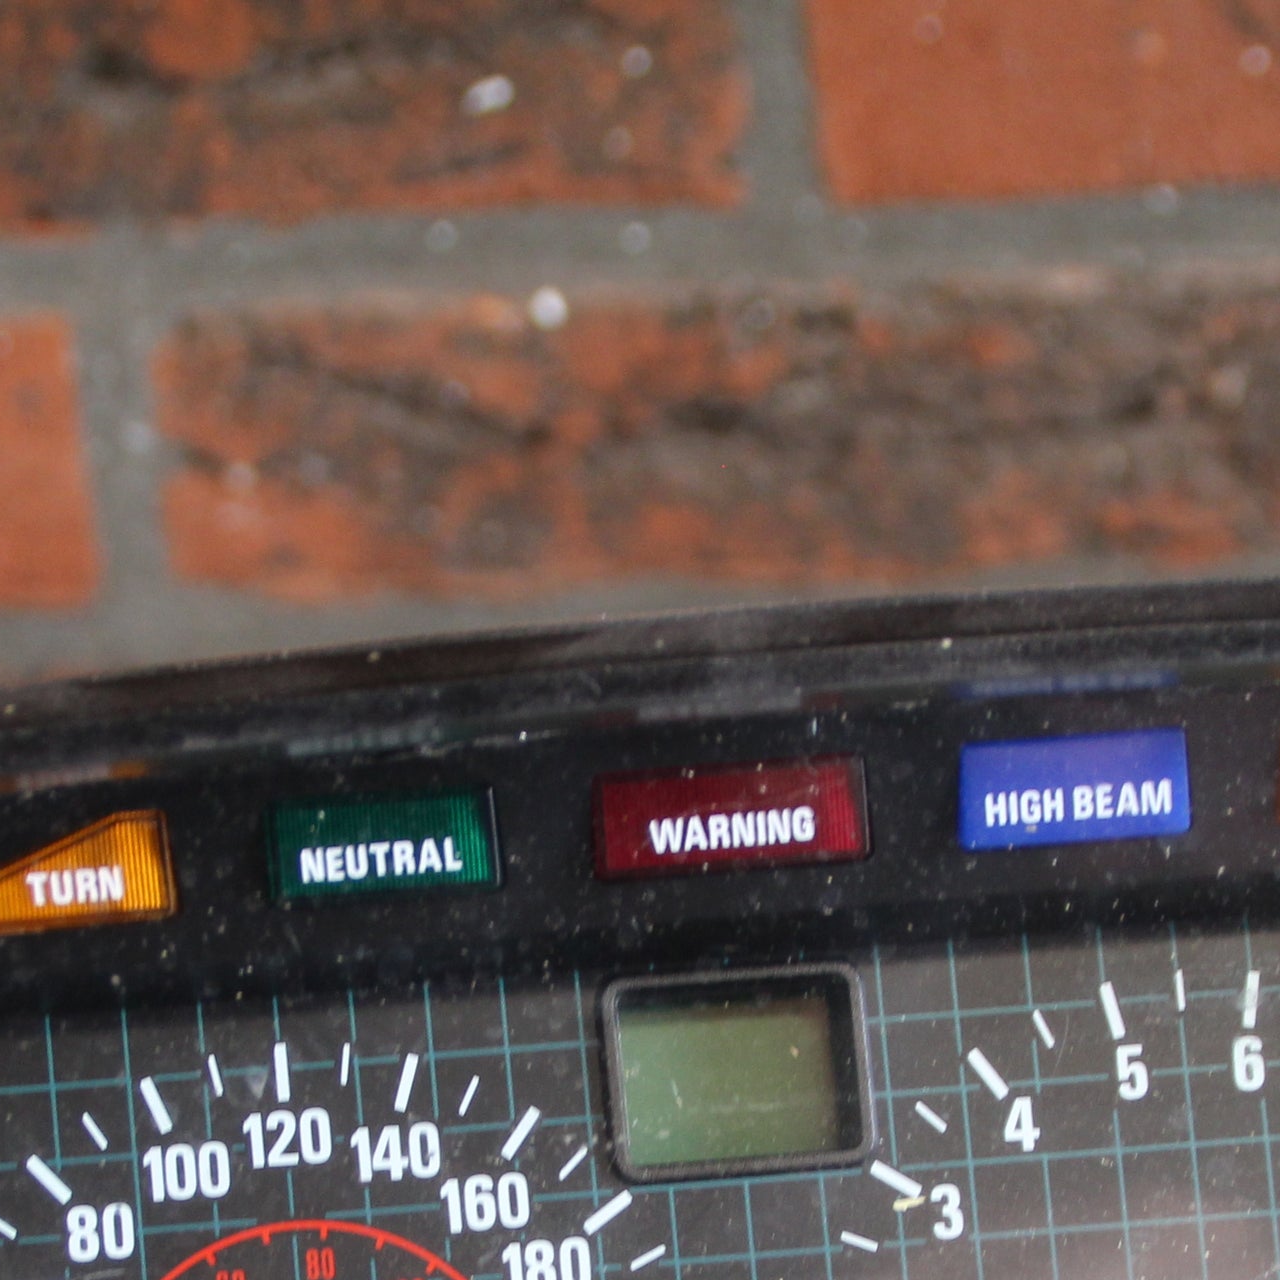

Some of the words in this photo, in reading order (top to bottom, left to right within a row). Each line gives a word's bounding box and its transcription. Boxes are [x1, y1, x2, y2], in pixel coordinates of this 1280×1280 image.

[650, 806, 815, 855] WARNING
[985, 791, 1065, 827] HIGH
[1073, 780, 1172, 820] BEAM
[26, 865, 123, 905] TURN
[300, 837, 462, 882] NEUTRAL
[1118, 1043, 1148, 1100] 5
[1233, 1037, 1264, 1091] 6
[242, 1108, 332, 1167] 120
[1004, 1097, 1040, 1150] 4
[143, 1141, 231, 1200] 100
[350, 1122, 440, 1181] 140
[440, 1173, 529, 1233] 160
[931, 1184, 963, 1240] 3
[66, 1202, 134, 1262] 80
[306, 1248, 336, 1280] 80
